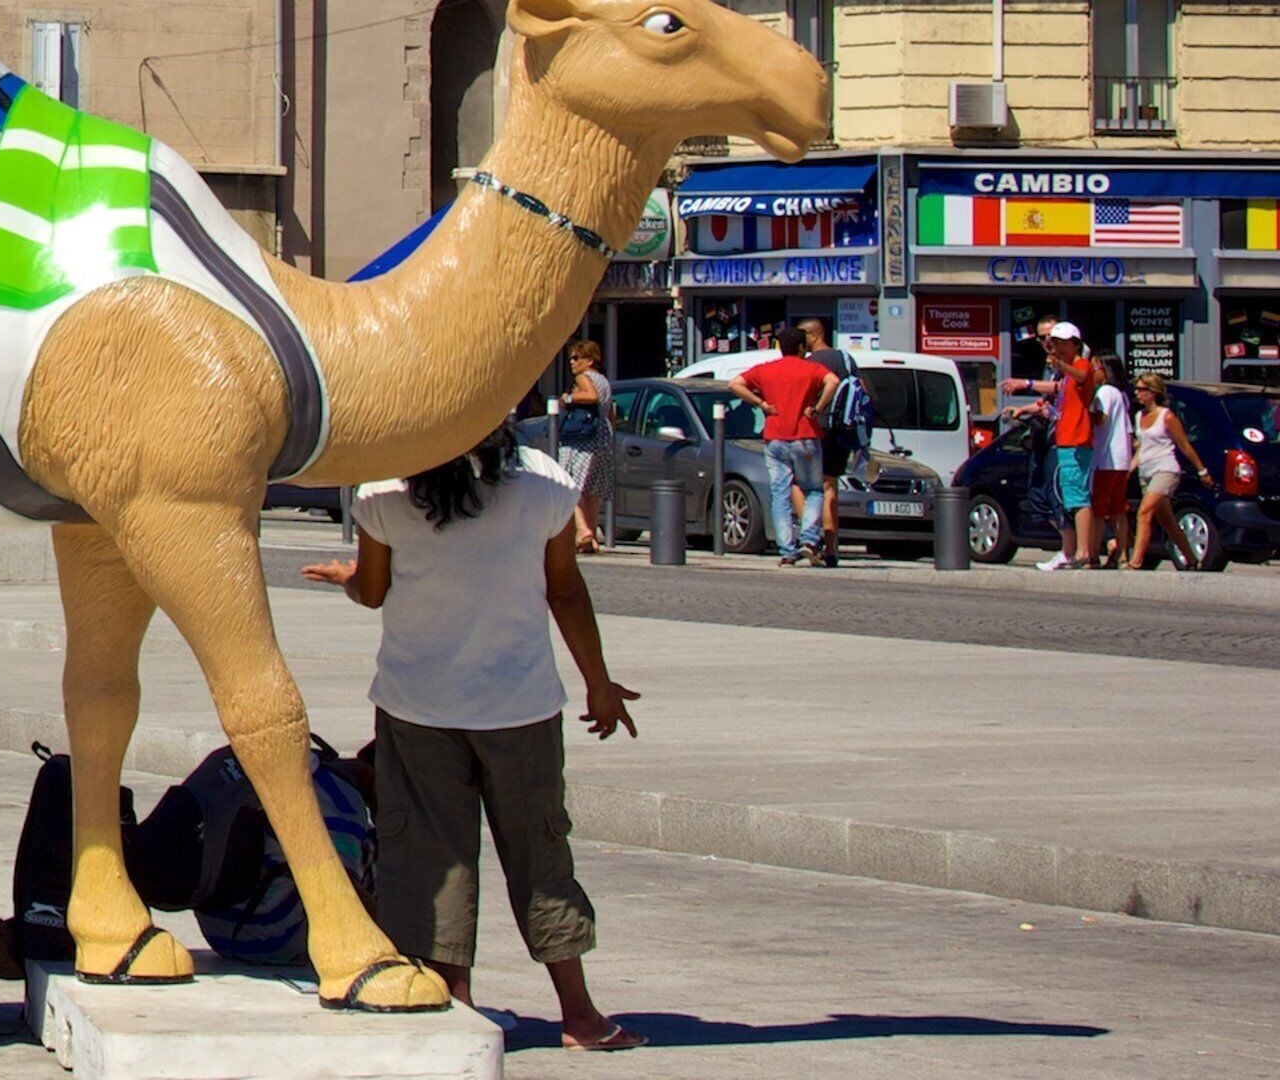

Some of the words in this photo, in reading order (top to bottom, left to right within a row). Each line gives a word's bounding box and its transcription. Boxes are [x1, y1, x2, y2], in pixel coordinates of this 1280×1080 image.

[974, 173, 1111, 194] CAMBIO
[679, 196, 752, 215] CAMBIO
[692, 257, 764, 284] CAMBIO
[784, 256, 862, 283] CHANGE
[989, 256, 1126, 285] CAMBIO
[929, 309, 970, 320] Thomas
[1130, 307, 1172, 316] ACHAT
[942, 320, 970, 329] Cook
[1130, 318, 1172, 326] VENTE
[1133, 349, 1173, 358] ENGLISH
[1134, 358, 1173, 367] ITALIAN
